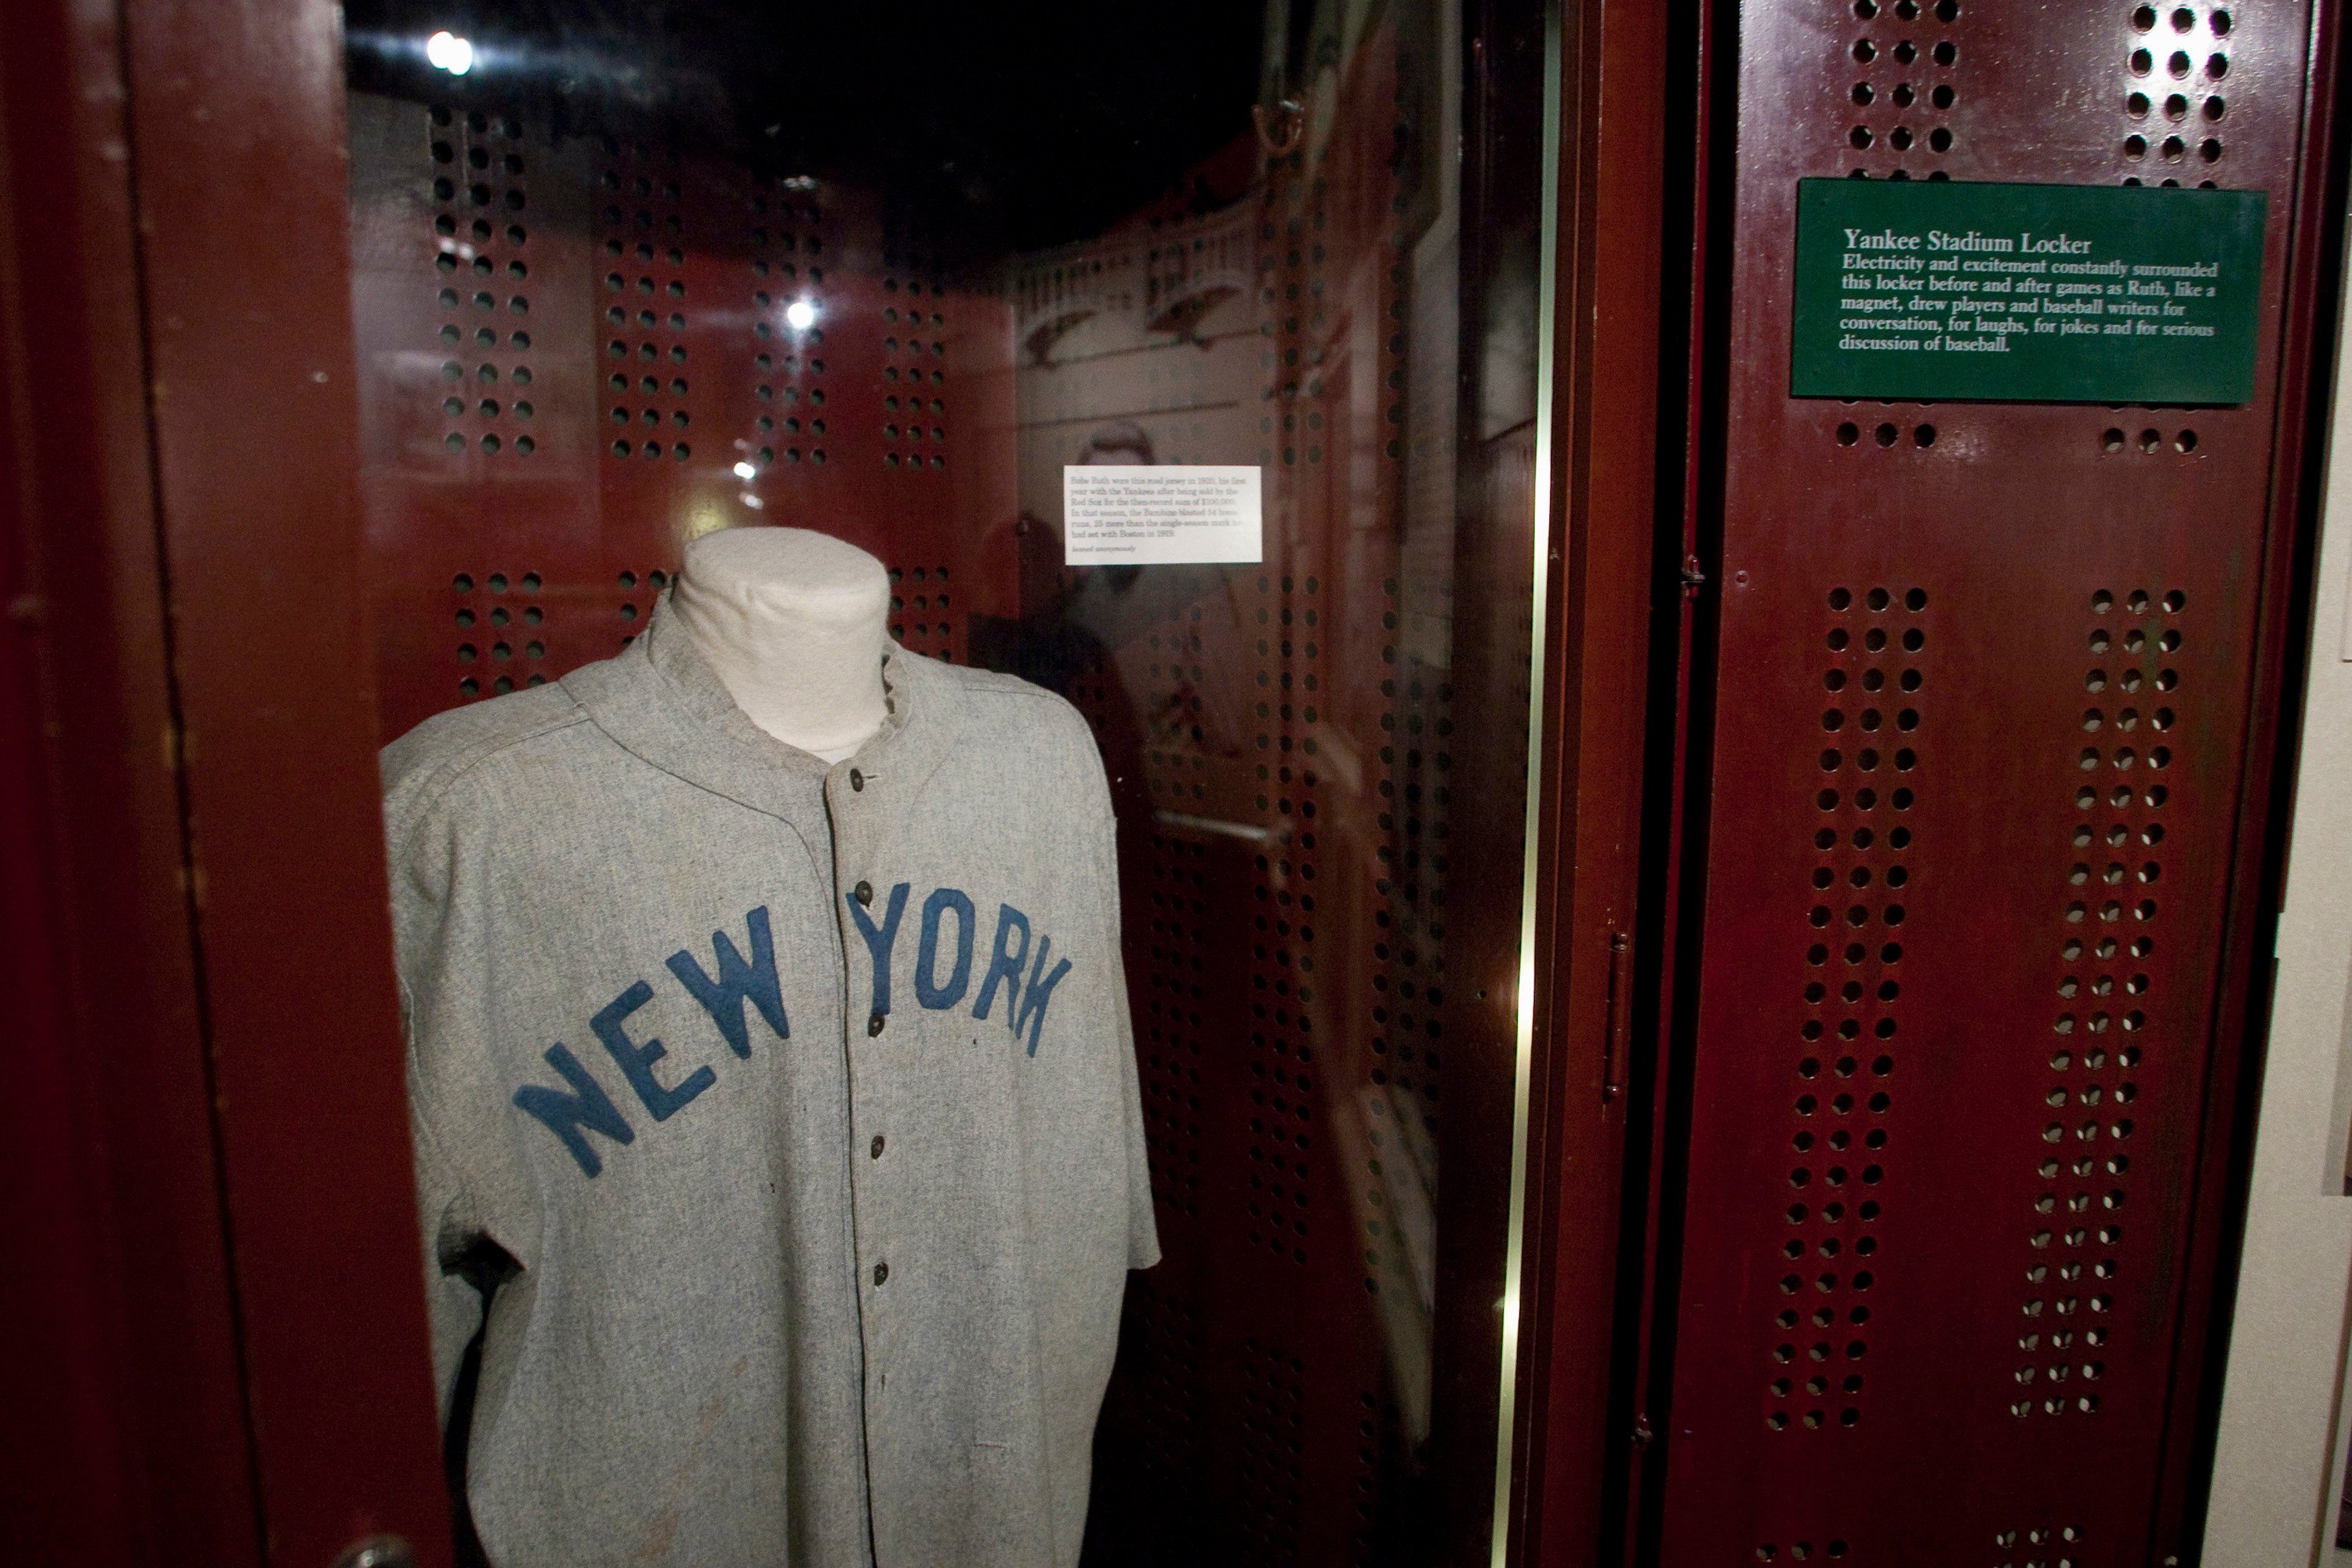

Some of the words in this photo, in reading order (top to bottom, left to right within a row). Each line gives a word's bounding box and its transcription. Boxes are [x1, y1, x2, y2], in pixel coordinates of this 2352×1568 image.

[1844, 229, 1922, 249] Yankee
[1927, 230, 2013, 252] Stadium
[2020, 233, 2092, 254] Locker
[1842, 253, 1926, 273] Electricity
[1929, 255, 1958, 271] and
[1962, 257, 2047, 273] excitement
[2051, 260, 2129, 278] constantly
[2132, 262, 2219, 278] surrounded
[1842, 274, 1871, 290] this
[1875, 274, 1925, 291] locker
[1929, 275, 1978, 291] before
[1982, 277, 2012, 292] and
[2016, 278, 2053, 293] after
[2056, 282, 2103, 296] games
[2107, 284, 2123, 295] as
[2127, 280, 2170, 298] Ruth,
[2174, 281, 2202, 296] like
[2205, 286, 2216, 297] a
[1840, 296, 1904, 314] magnet,
[1908, 295, 1947, 310] drew
[1951, 296, 2005, 314] players
[2009, 297, 2038, 314] and
[2042, 298, 2104, 314] baseball
[2107, 300, 2160, 315] writers
[2163, 301, 2187, 316] for
[1839, 315, 1943, 333] conversation,
[1947, 316, 1971, 331] for
[1975, 316, 2029, 335] laughs,
[2034, 318, 2057, 333] for
[2060, 318, 2100, 336] jokes
[2103, 319, 2132, 335] and
[2136, 320, 2158, 335] for
[2162, 322, 2215, 336] serious
[1838, 334, 1919, 350] discussion
[1924, 336, 1942, 350] of
[1946, 336, 2011, 352] baseball.
[1164, 477, 1186, 486] jersey
[1177, 488, 1197, 496] being
[1215, 488, 1224, 496] by
[1071, 530, 1086, 539] had
[512, 905, 789, 1178] NEW
[847, 882, 1073, 1058] YORK
